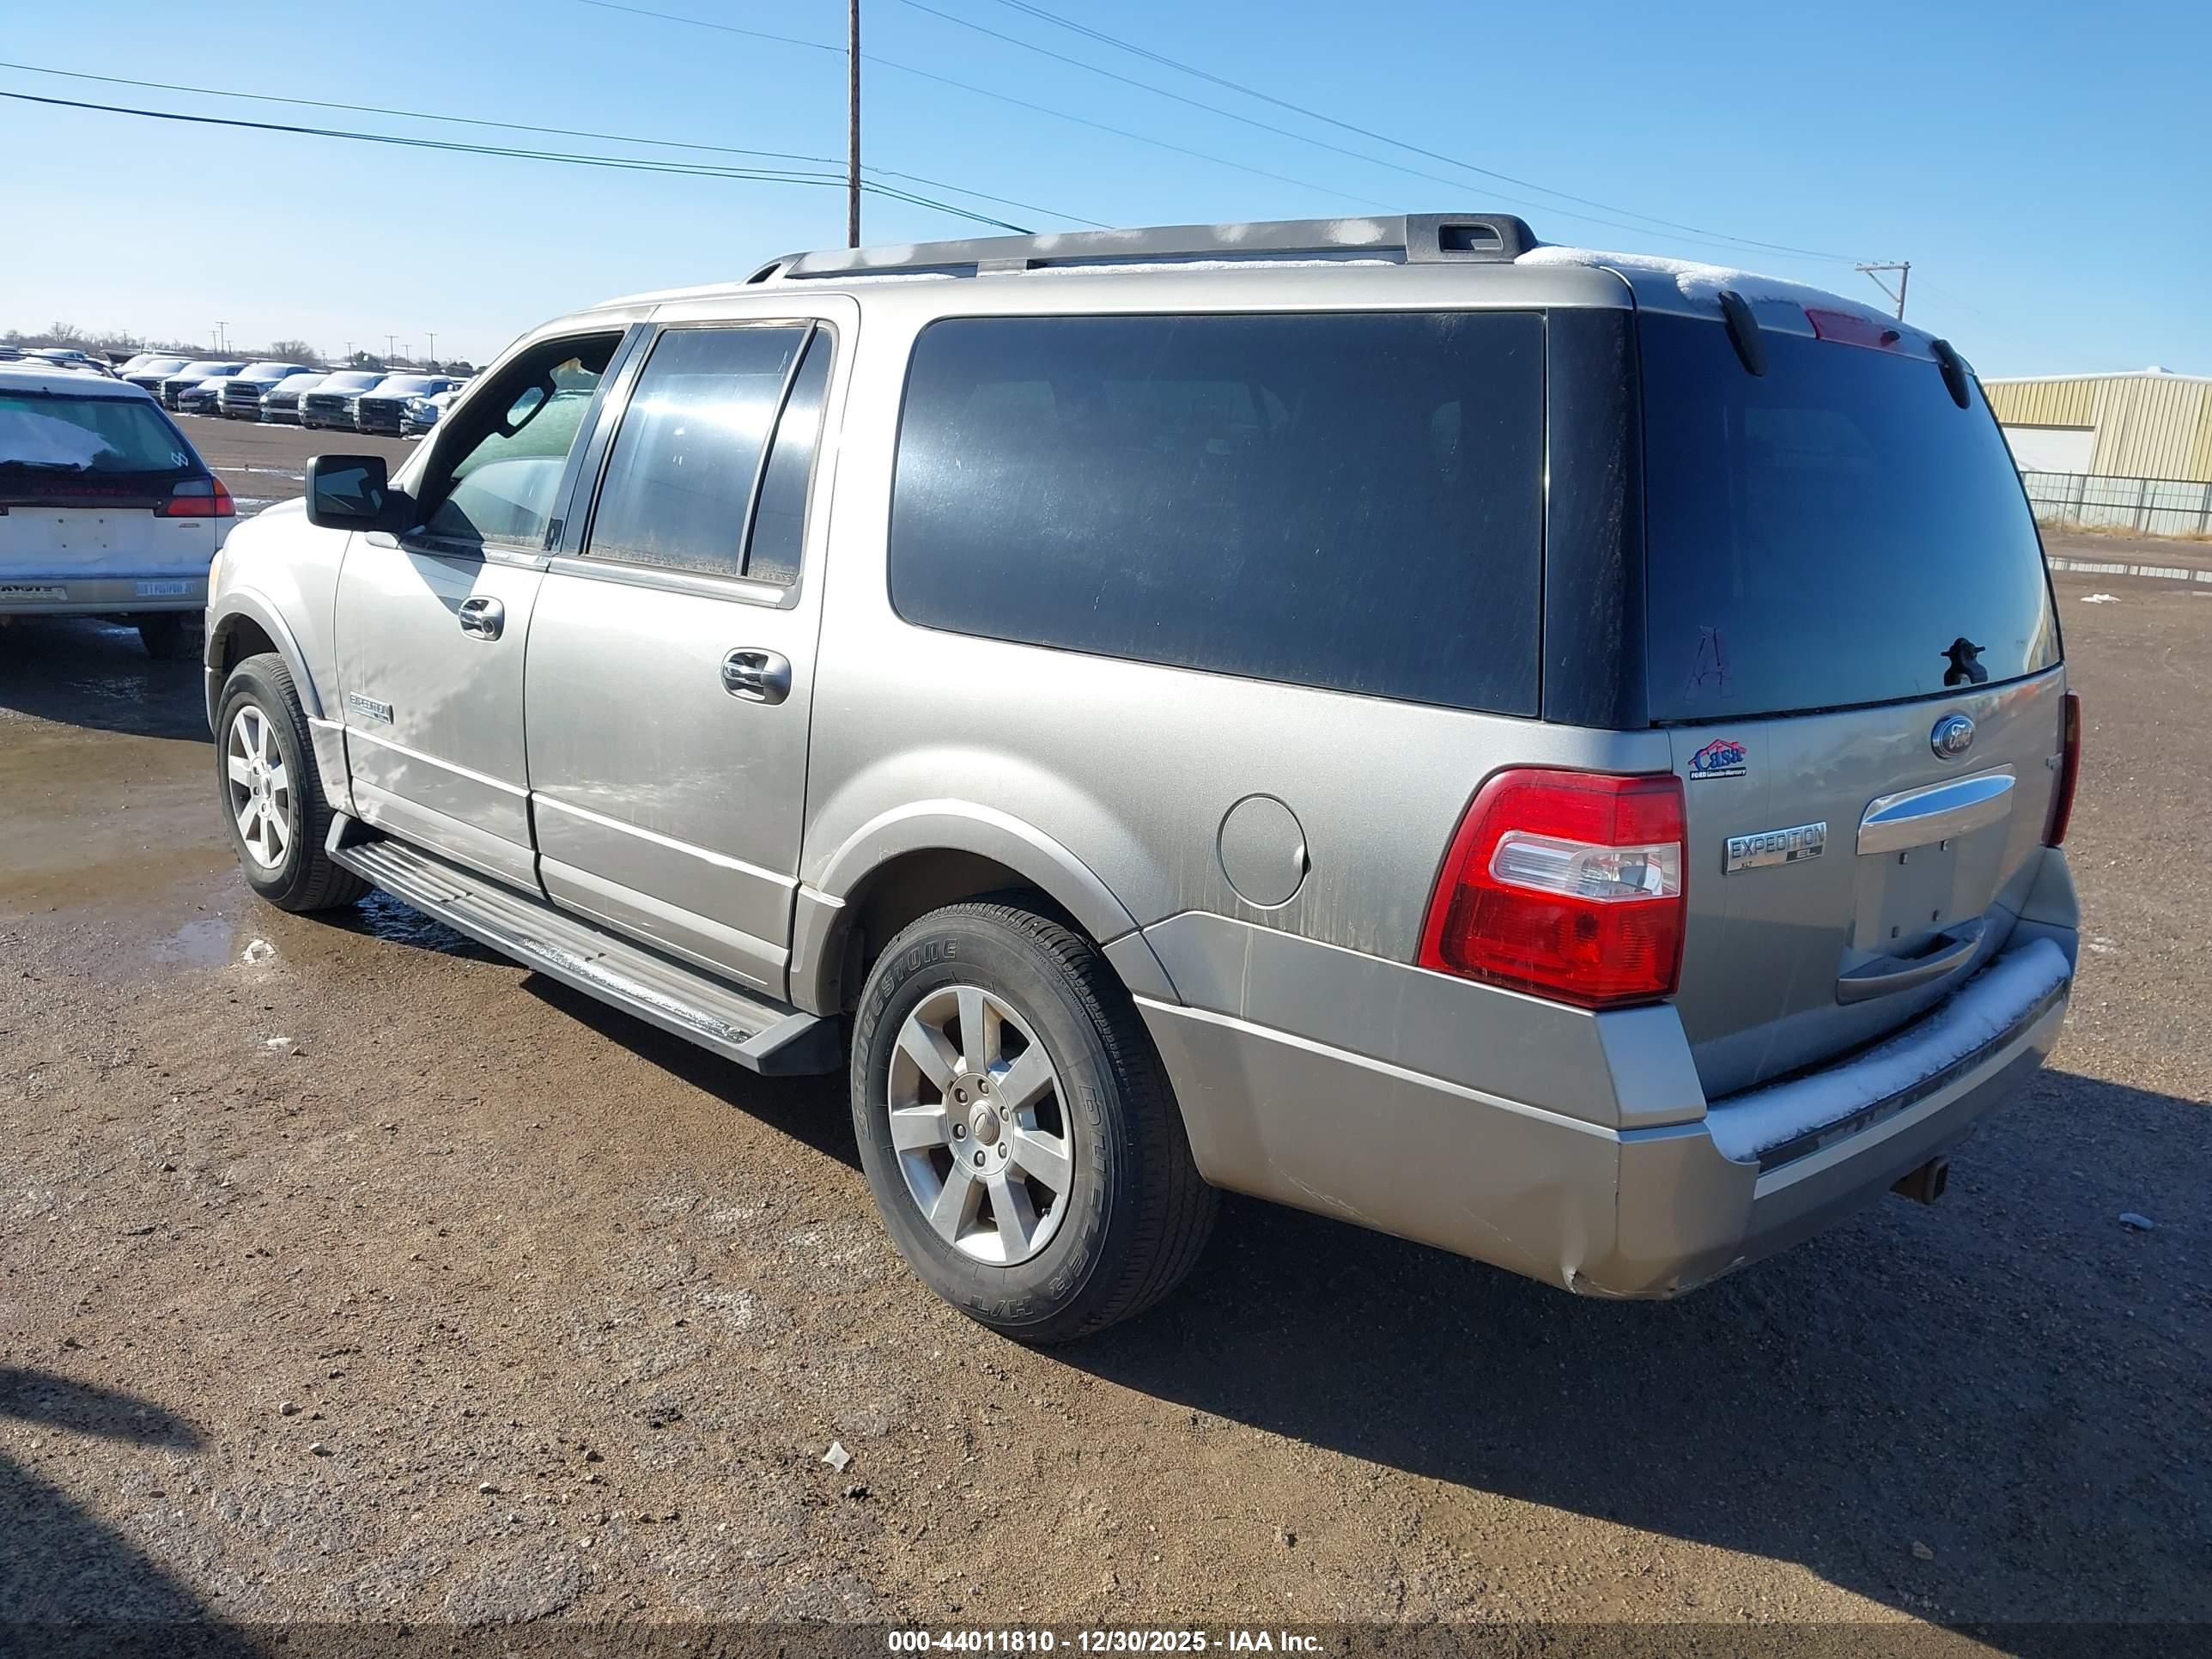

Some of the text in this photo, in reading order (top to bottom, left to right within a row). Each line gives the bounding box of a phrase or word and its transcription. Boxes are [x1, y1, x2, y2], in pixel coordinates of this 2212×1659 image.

[1950, 724, 1972, 749] Ford
[1695, 749, 1743, 770] Casa
[1731, 824, 1826, 859] EXPEDITION
[1797, 848, 1816, 859] EL
[856, 938, 959, 1140] BRIDGESTONE
[1048, 1085, 1106, 1300] DUELER
[963, 1295, 1035, 1319] H/T
